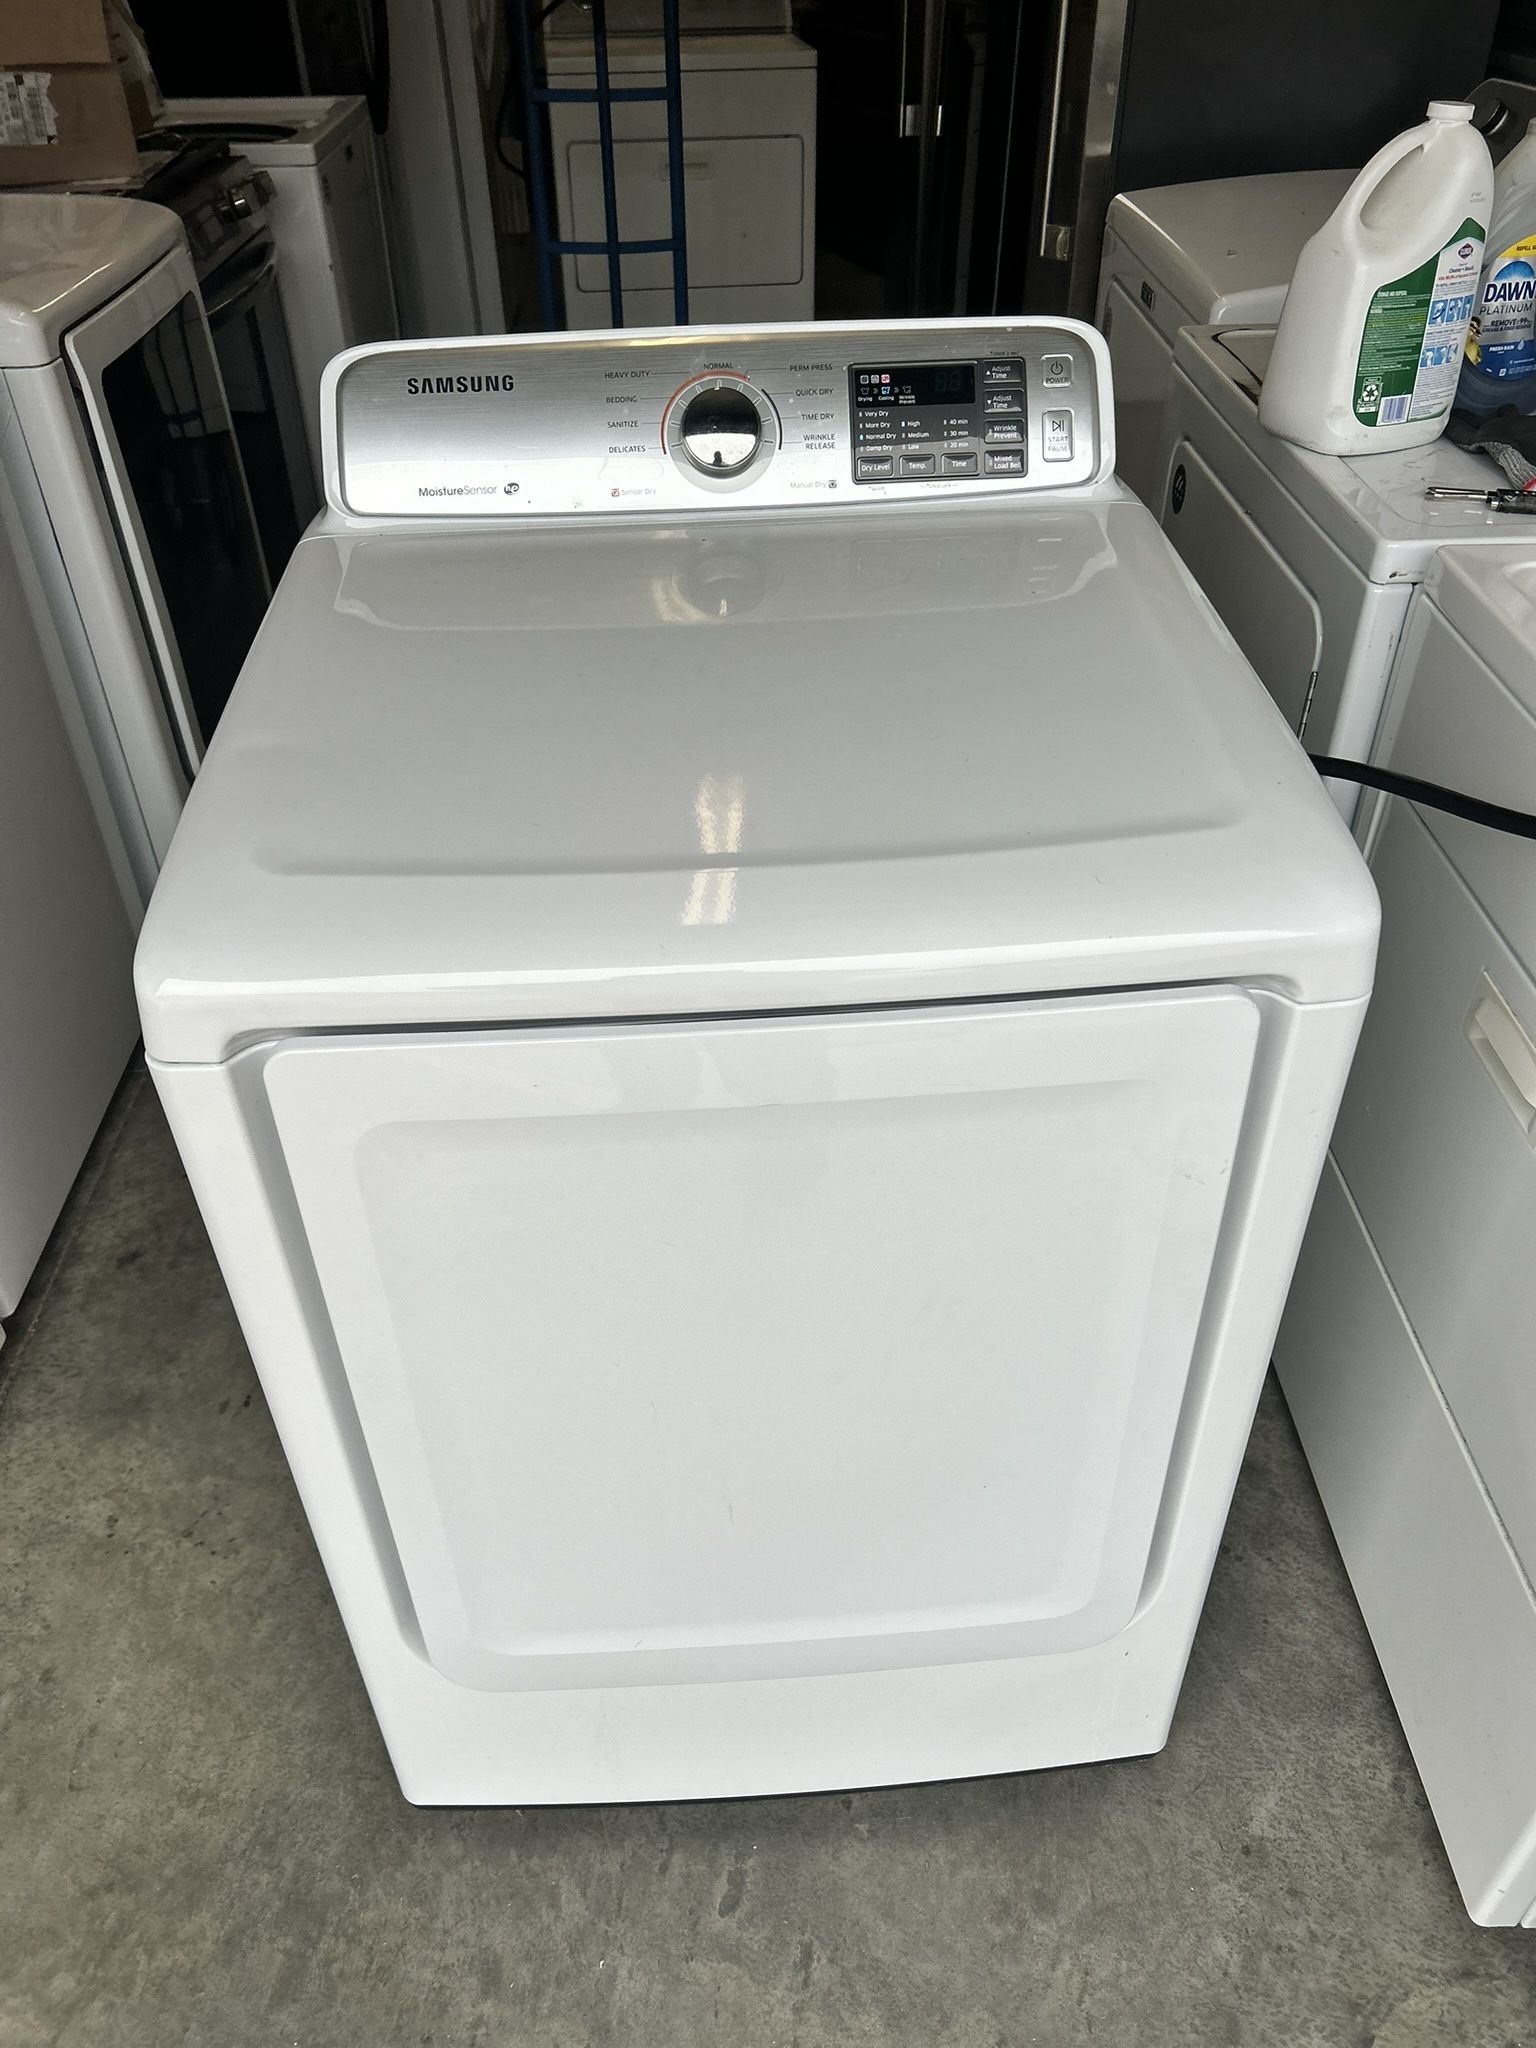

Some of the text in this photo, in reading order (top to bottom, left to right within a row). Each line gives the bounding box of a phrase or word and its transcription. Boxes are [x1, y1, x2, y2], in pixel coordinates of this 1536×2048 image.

[1484, 281, 1536, 302] DAWN
[1479, 303, 1533, 315] PLATINUM
[1491, 319, 1516, 327] REMOVE
[703, 362, 733, 370] NORMAL
[789, 363, 833, 372] PERM PRESS
[992, 365, 1011, 373] Adjust
[604, 370, 650, 379] HEAVY DUTY
[407, 375, 514, 395] SAMSUNG
[992, 394, 1012, 402] Adjust
[993, 401, 1008, 409] Time
[607, 420, 639, 428] SANITIZE
[993, 424, 1017, 432] Wrinkle
[803, 433, 836, 441] WRINKLE
[993, 431, 1017, 439] Prevent
[608, 445, 646, 454] DELICATES
[883, 444, 893, 452] Dry
[861, 463, 891, 472] Dry Level
[909, 461, 926, 470] Temp.
[993, 461, 1022, 469] Load Bell
[815, 480, 827, 488] Dry
[418, 485, 498, 497] MoistureSensor
[645, 488, 657, 496] Dry
